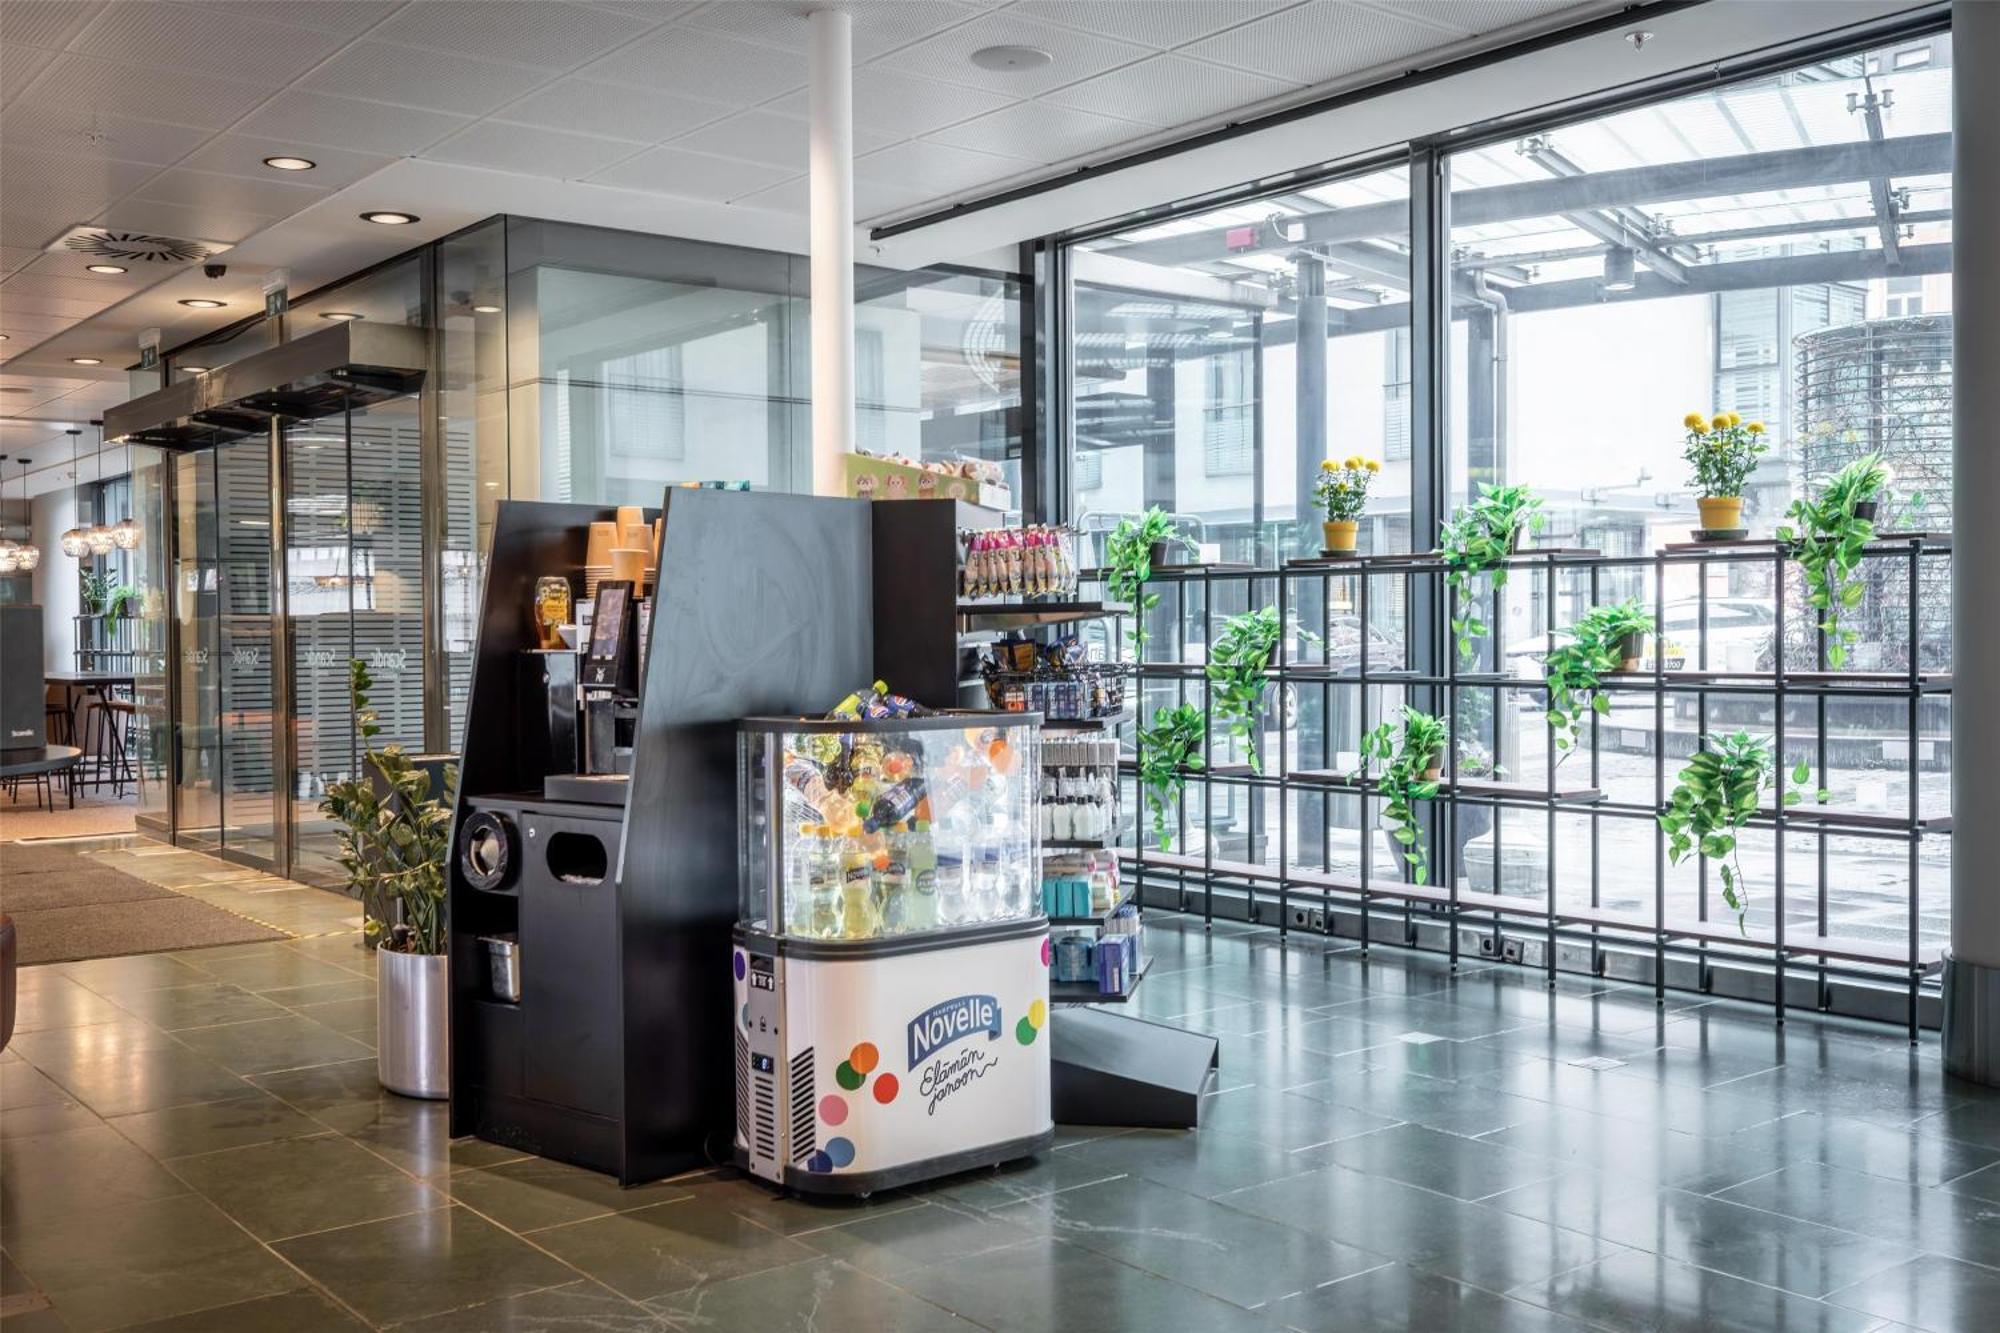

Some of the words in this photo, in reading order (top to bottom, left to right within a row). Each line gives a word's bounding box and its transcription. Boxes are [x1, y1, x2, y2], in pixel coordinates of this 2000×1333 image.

[914, 999, 993, 1060] Novelle
[920, 1048, 985, 1097] Elämän
[928, 1057, 998, 1116] janoon
